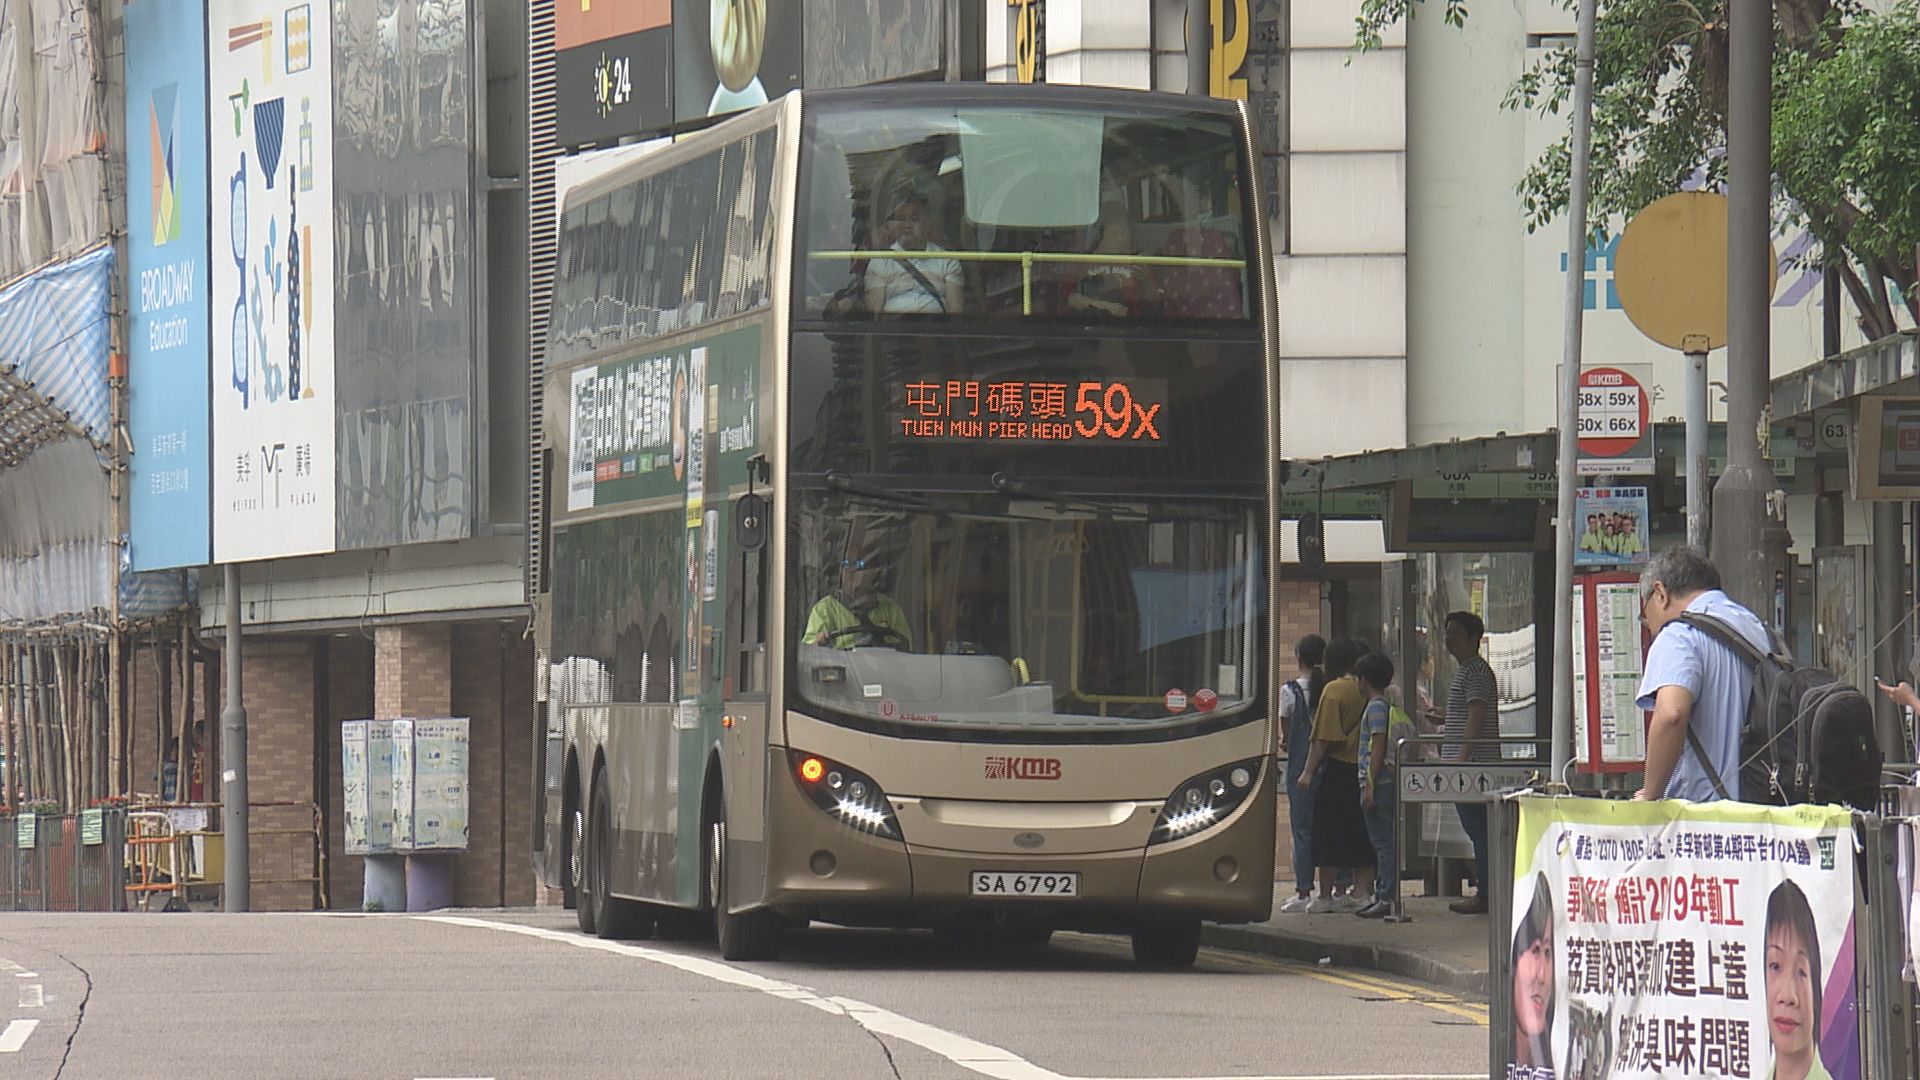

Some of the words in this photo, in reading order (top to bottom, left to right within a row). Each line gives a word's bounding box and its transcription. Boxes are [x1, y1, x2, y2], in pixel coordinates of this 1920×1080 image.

[613, 56, 631, 104] 24
[141, 257, 194, 313] BROADWAY
[150, 313, 188, 351] Education
[904, 380, 1066, 418] 屯門碼頭
[901, 419, 944, 437] TUEN
[950, 420, 983, 437] MUN
[988, 421, 1027, 439] PIER
[1032, 422, 1073, 439] HEAD
[1826, 424, 1848, 438] 63
[1006, 756, 1062, 781] KMB
[1620, 839, 1645, 862] 1805
[977, 875, 1006, 893] SA
[1013, 875, 1072, 894] 6792
[1566, 936, 1749, 1000] 荔寶路明渠加建上蓋
[1614, 1014, 1750, 1080] 解決臭味問題
